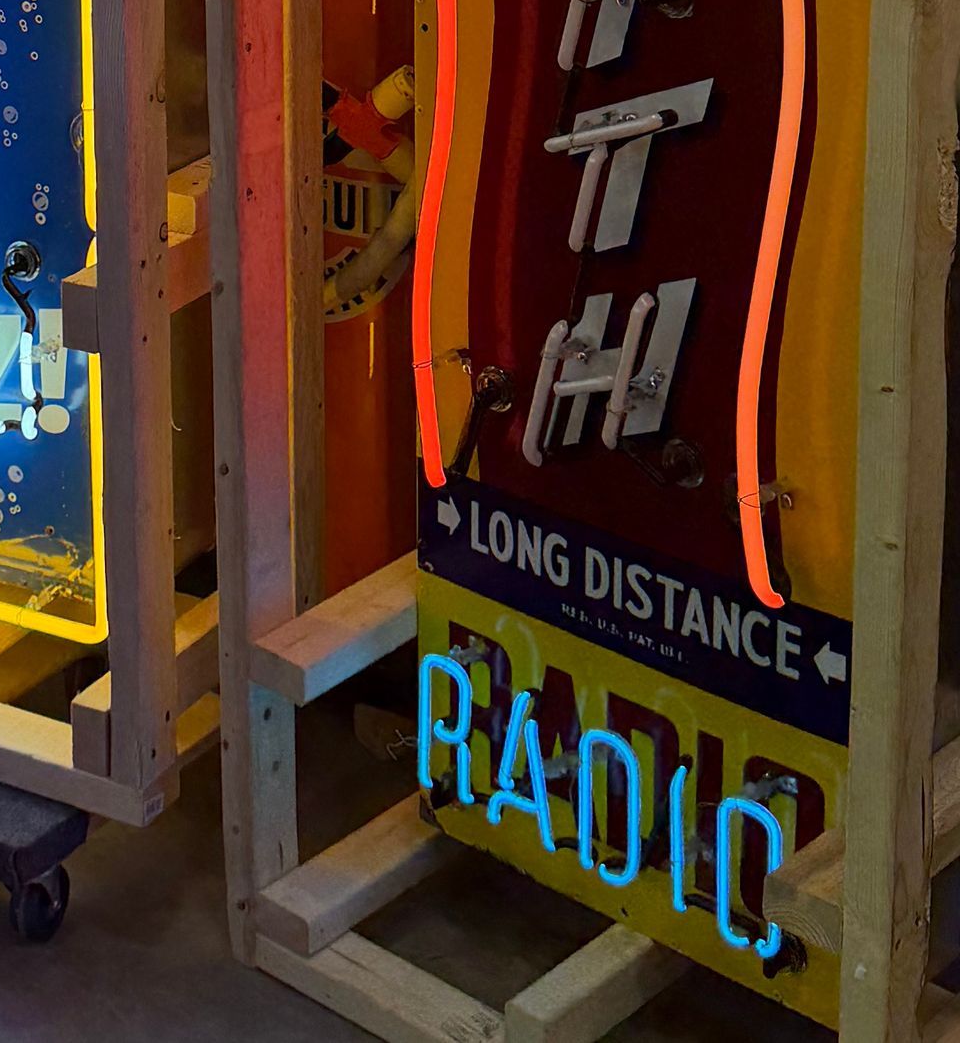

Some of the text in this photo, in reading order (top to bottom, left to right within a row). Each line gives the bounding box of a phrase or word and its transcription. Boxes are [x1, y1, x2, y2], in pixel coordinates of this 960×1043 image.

[469, 500, 804, 681] LONG DISTANCE
[417, 620, 826, 958] RADIO
